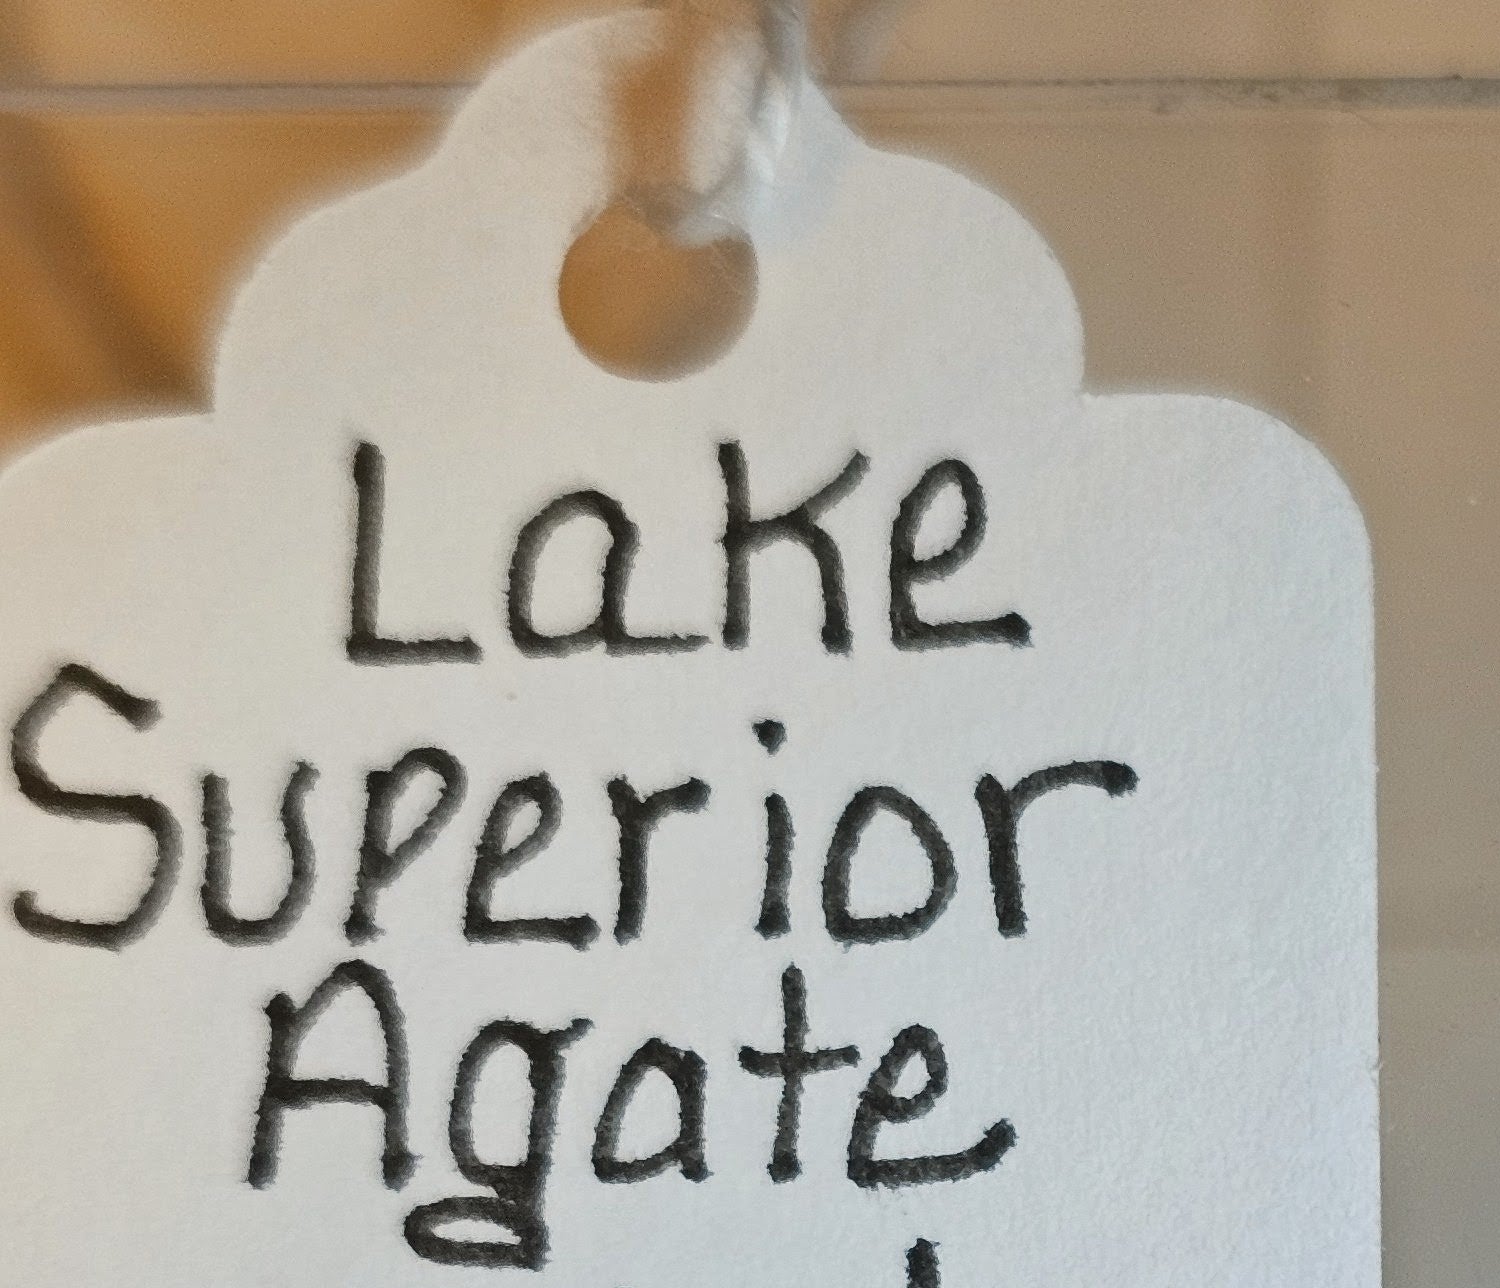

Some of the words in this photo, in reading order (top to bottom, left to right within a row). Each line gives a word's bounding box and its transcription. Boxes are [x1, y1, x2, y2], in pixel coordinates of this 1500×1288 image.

[343, 438, 1033, 665] Lake
[9, 661, 1140, 951] Superior
[243, 957, 1018, 1273] Agate
